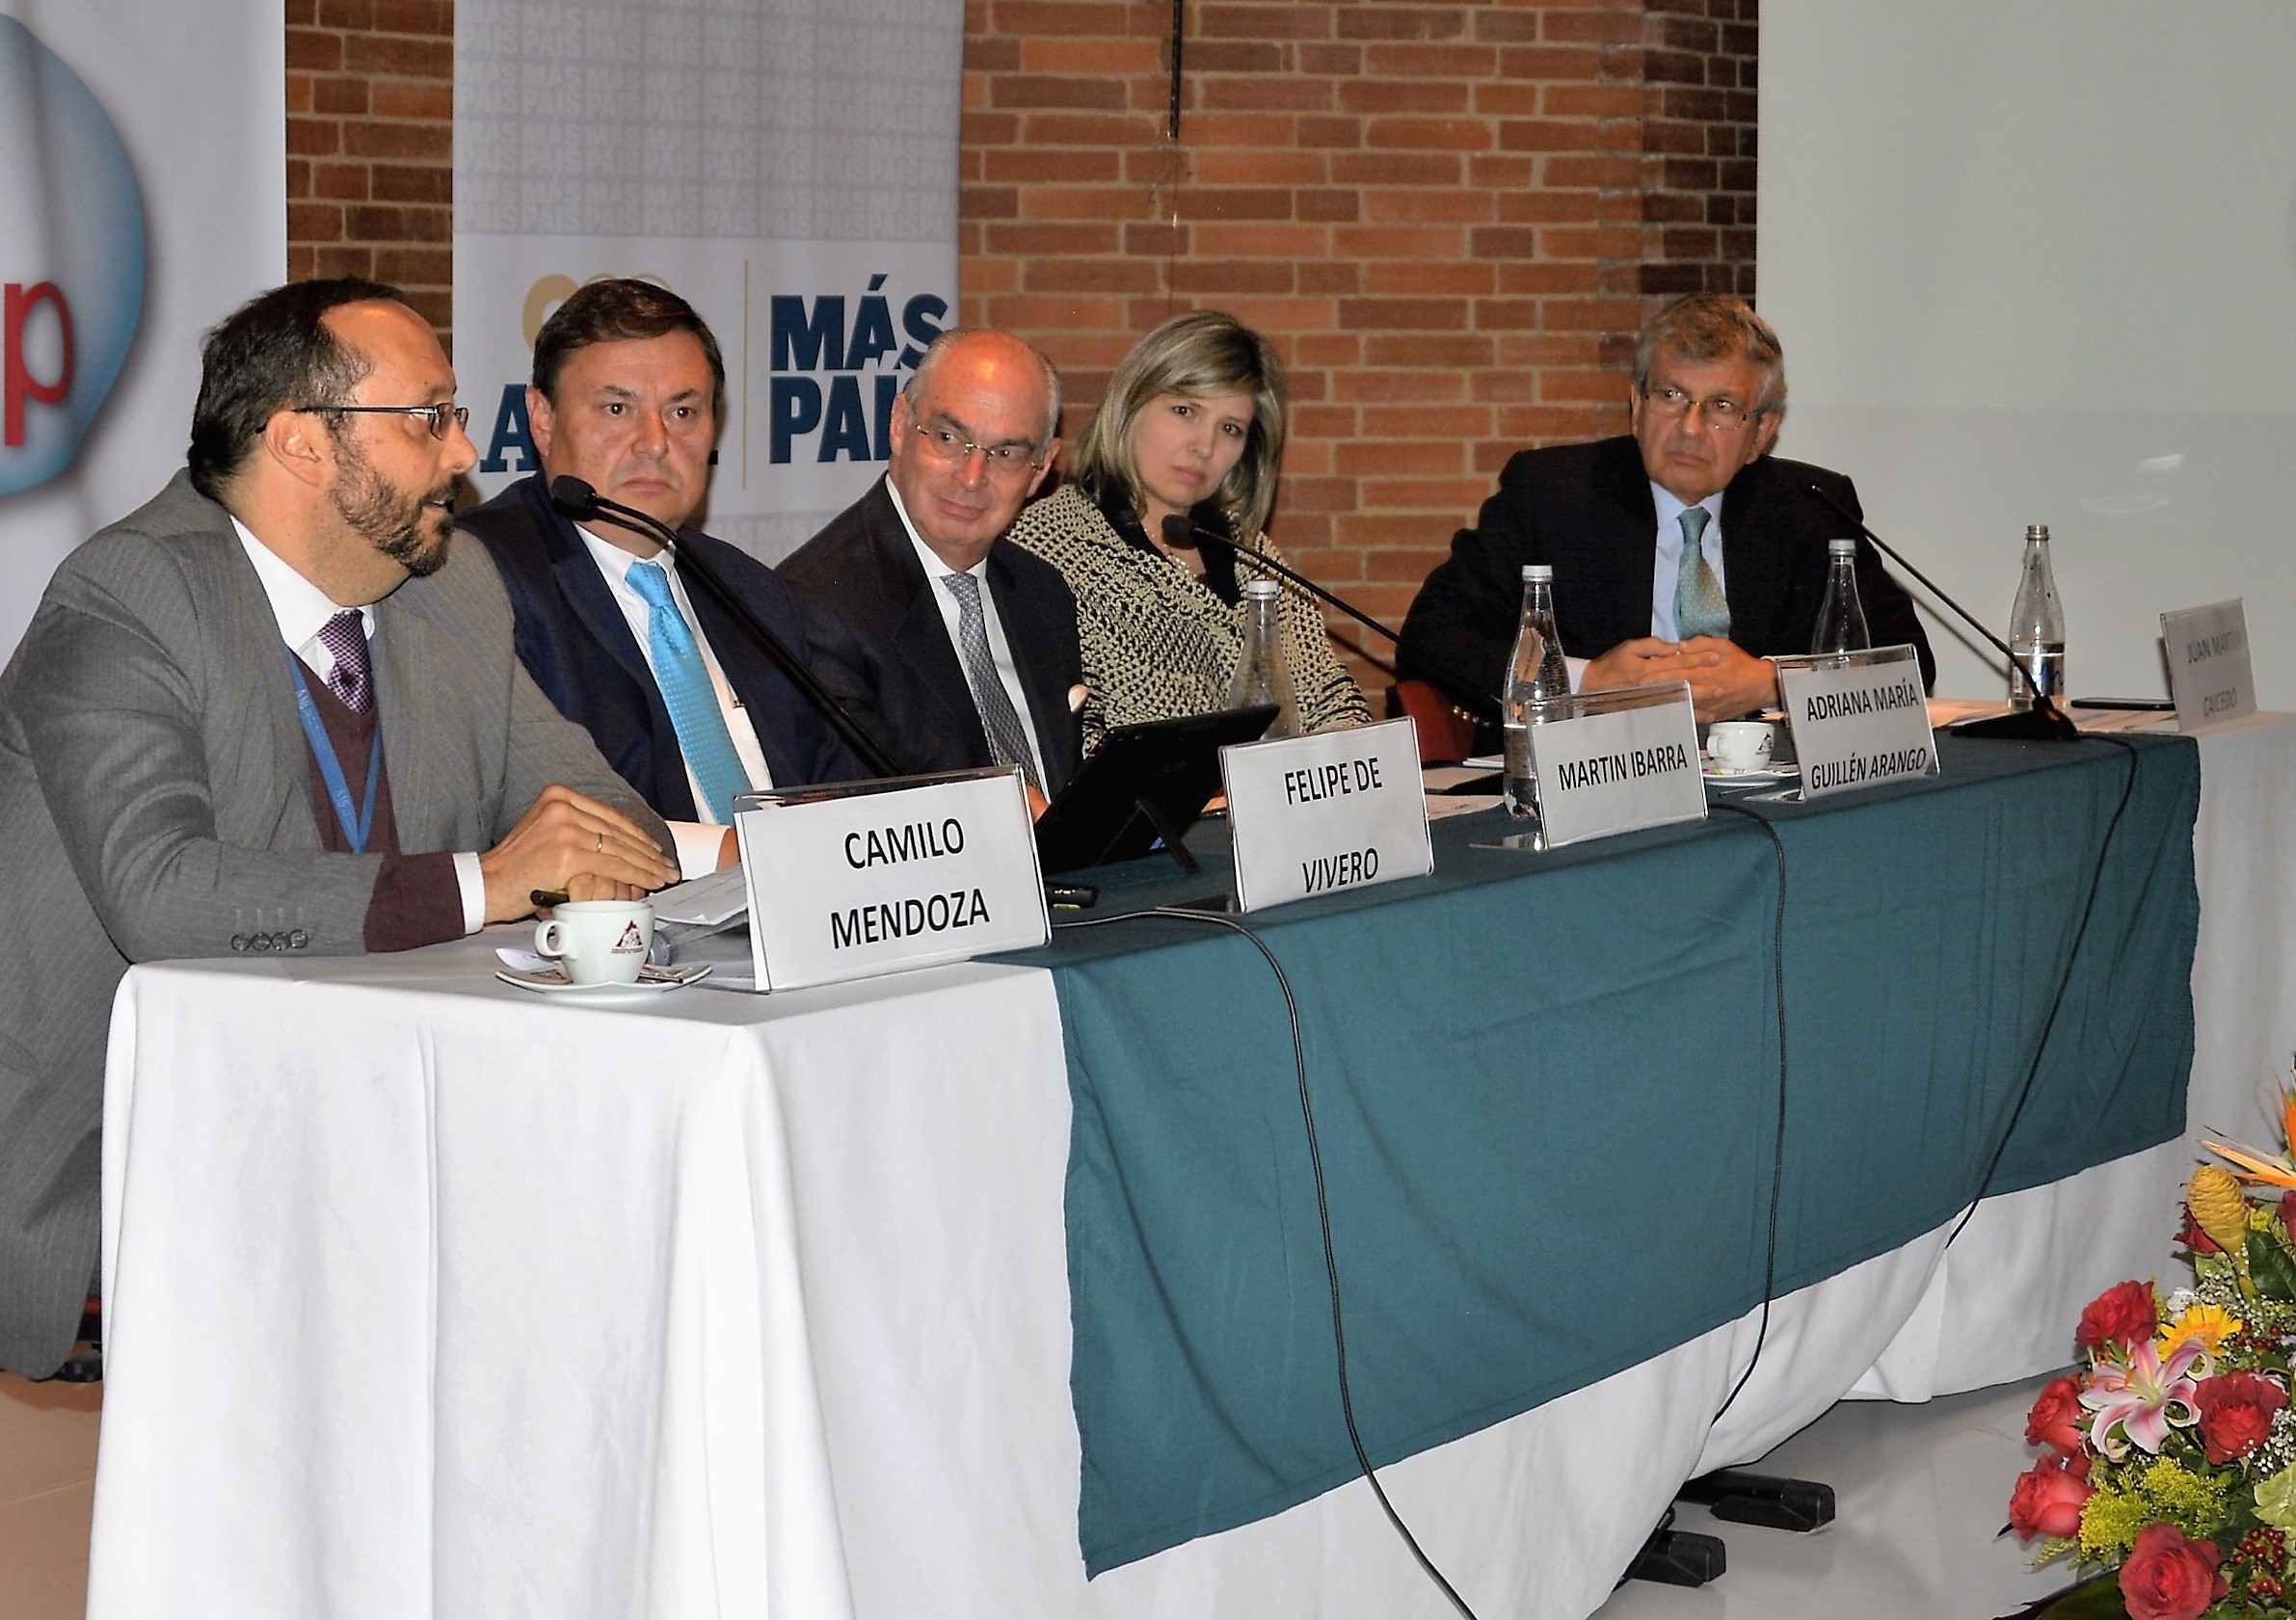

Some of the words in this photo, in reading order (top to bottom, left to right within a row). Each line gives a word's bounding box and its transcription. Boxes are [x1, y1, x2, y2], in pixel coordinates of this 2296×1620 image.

[770, 274, 948, 371] MÁS
[770, 373, 906, 464] PAÍ
[1806, 689, 1872, 722] ADRIANA
[1874, 678, 1919, 712] MARÍA
[1284, 762, 1351, 806] FELIPE
[1353, 757, 1383, 791] DE
[1558, 754, 1627, 791] MARTIN
[1630, 743, 1688, 779] IBARRA
[1810, 753, 1867, 789] GUILLÉN
[1869, 747, 1926, 779] ARANGO
[844, 818, 964, 869] CAMILO
[1301, 847, 1379, 893] VIVERO
[830, 888, 991, 949] MENDOZA
